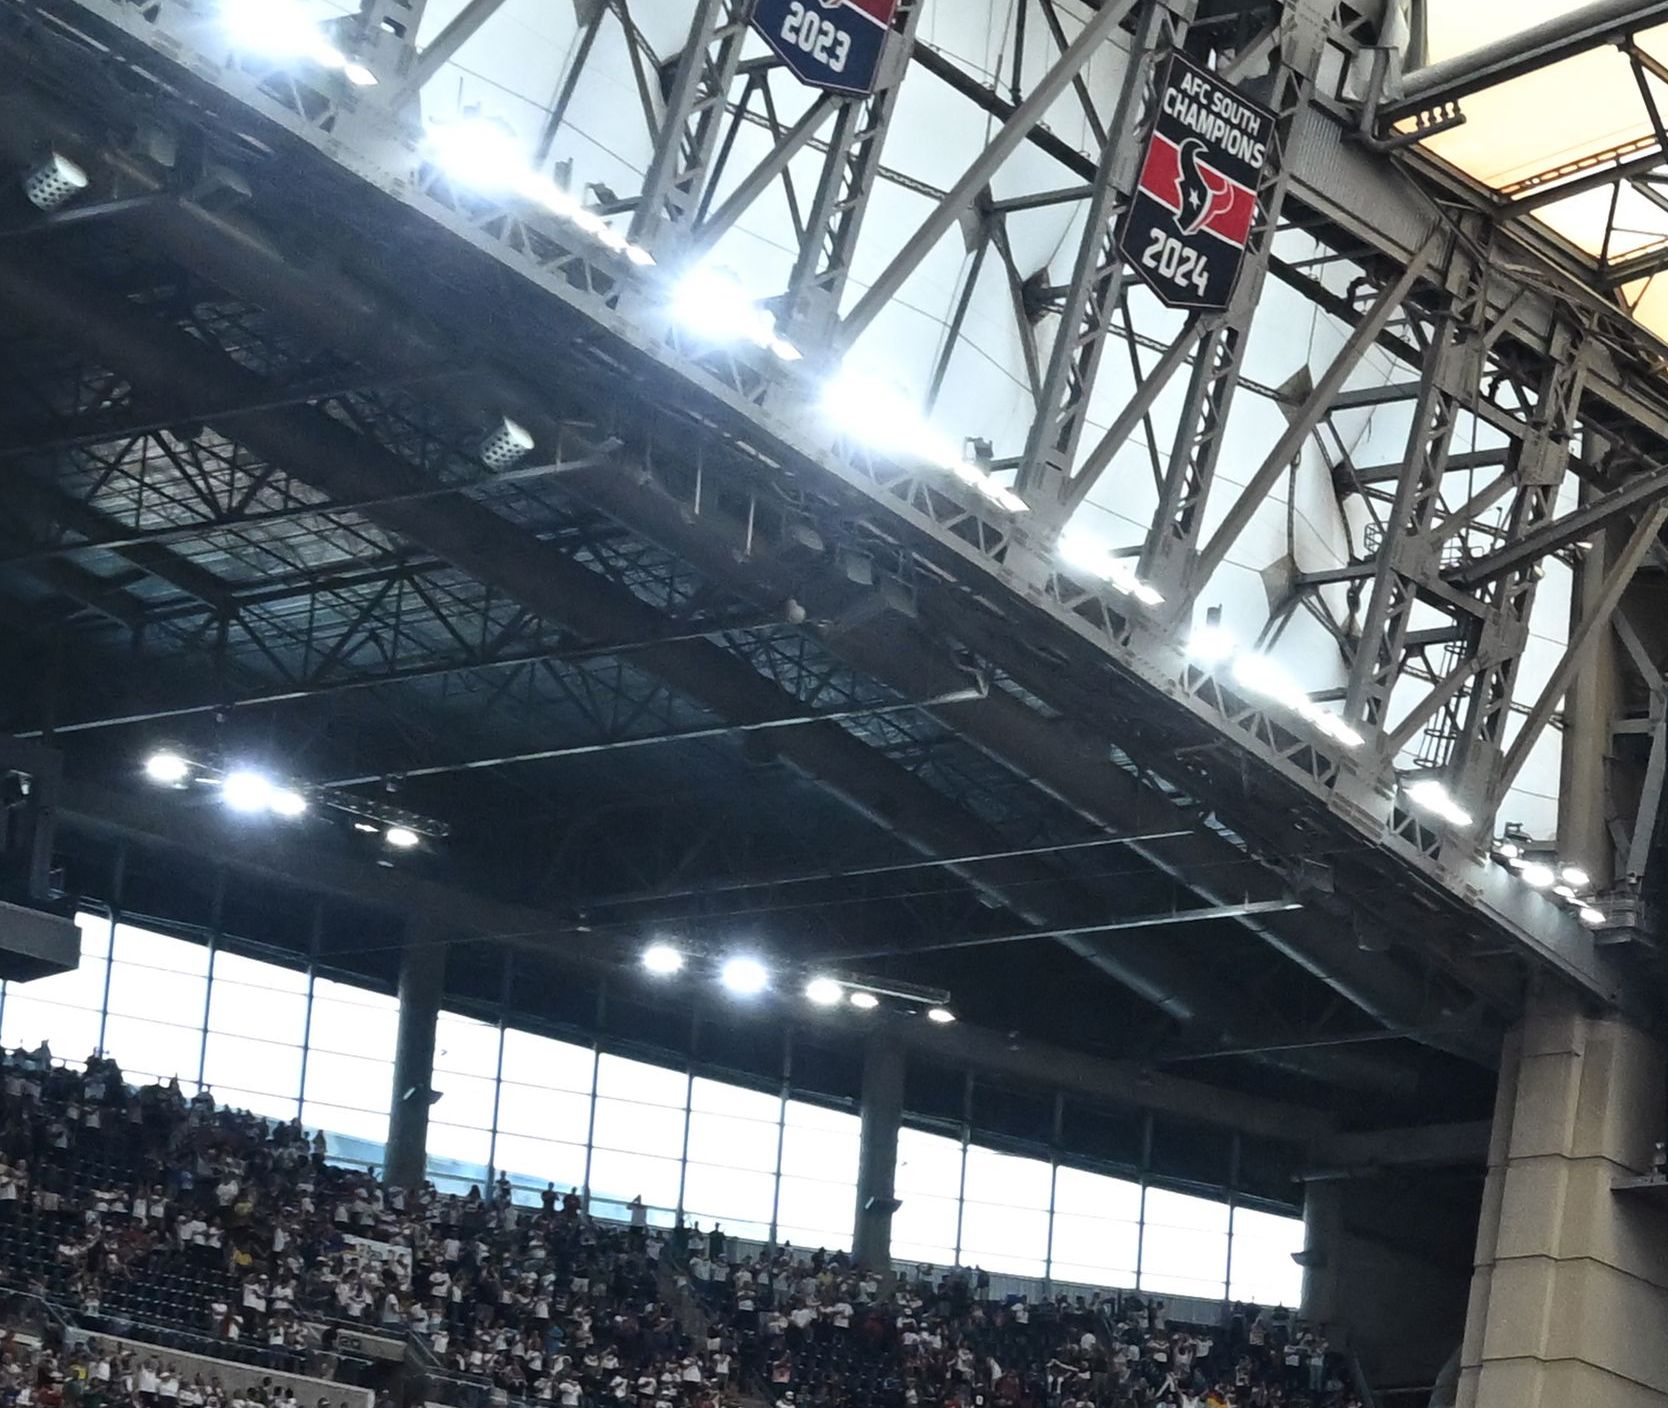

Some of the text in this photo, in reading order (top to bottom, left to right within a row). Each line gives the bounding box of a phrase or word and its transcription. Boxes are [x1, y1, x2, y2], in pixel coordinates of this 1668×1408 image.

[780, 8, 852, 74] 2023
[1163, 90, 1266, 169] CHAMPIONS
[1180, 74, 1262, 137] AFC SOUTH
[1142, 228, 1209, 297] 2024
